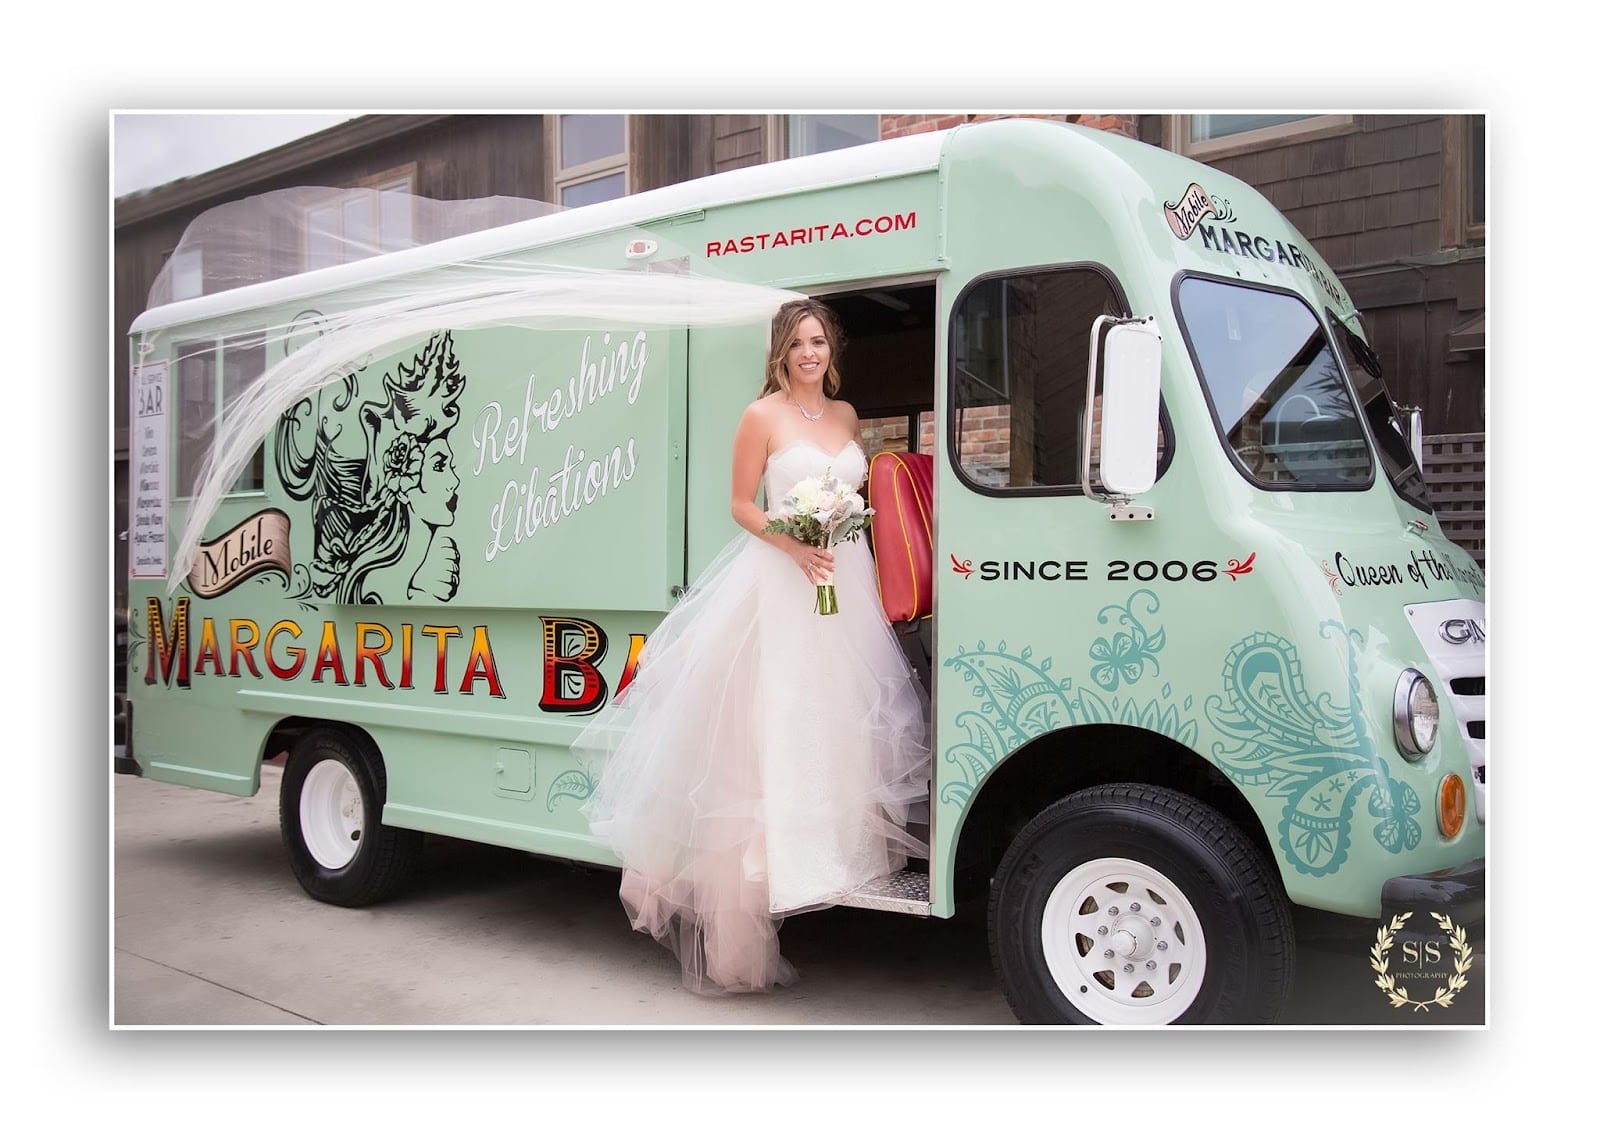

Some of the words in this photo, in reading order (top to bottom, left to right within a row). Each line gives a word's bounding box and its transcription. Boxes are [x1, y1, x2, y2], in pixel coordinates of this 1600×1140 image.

[706, 212, 916, 257] RASTARITA.COM
[1173, 190, 1209, 237] Mobile
[472, 330, 650, 476] Refreshing
[485, 438, 638, 562] Libations
[201, 517, 273, 588] Mobile
[980, 560, 1089, 581] SINCE
[1107, 560, 1218, 582] 2006
[1335, 551, 1403, 587] Queen
[1407, 550, 1429, 590] of
[144, 596, 507, 700] MARGARITA
